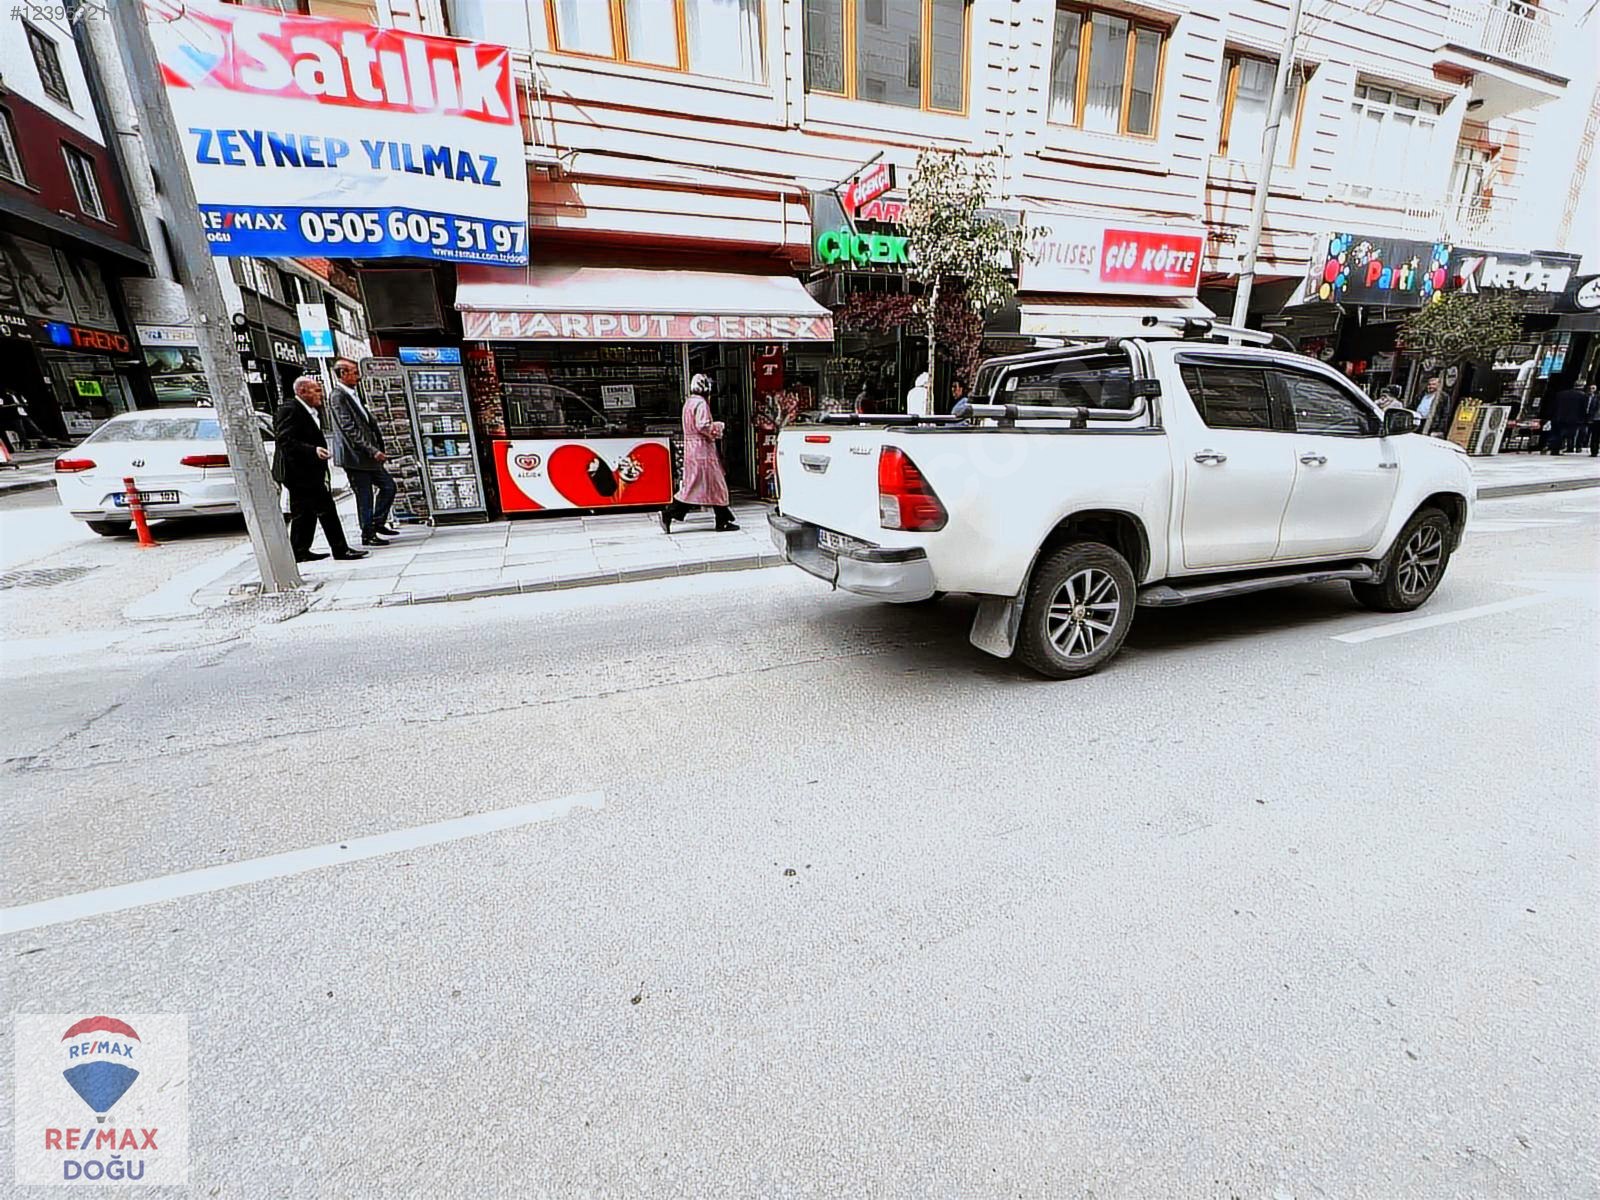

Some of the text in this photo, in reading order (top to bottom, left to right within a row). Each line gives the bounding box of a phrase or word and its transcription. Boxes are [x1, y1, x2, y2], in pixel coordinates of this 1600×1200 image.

[233, 16, 510, 119] Satılık
[188, 127, 501, 187] ZEYNEP YILMAZ
[300, 210, 525, 253] 0505 605 31 97
[1142, 244, 1196, 273] KÖFTE
[1366, 259, 1415, 291] Parti
[490, 312, 672, 337] HARPUT
